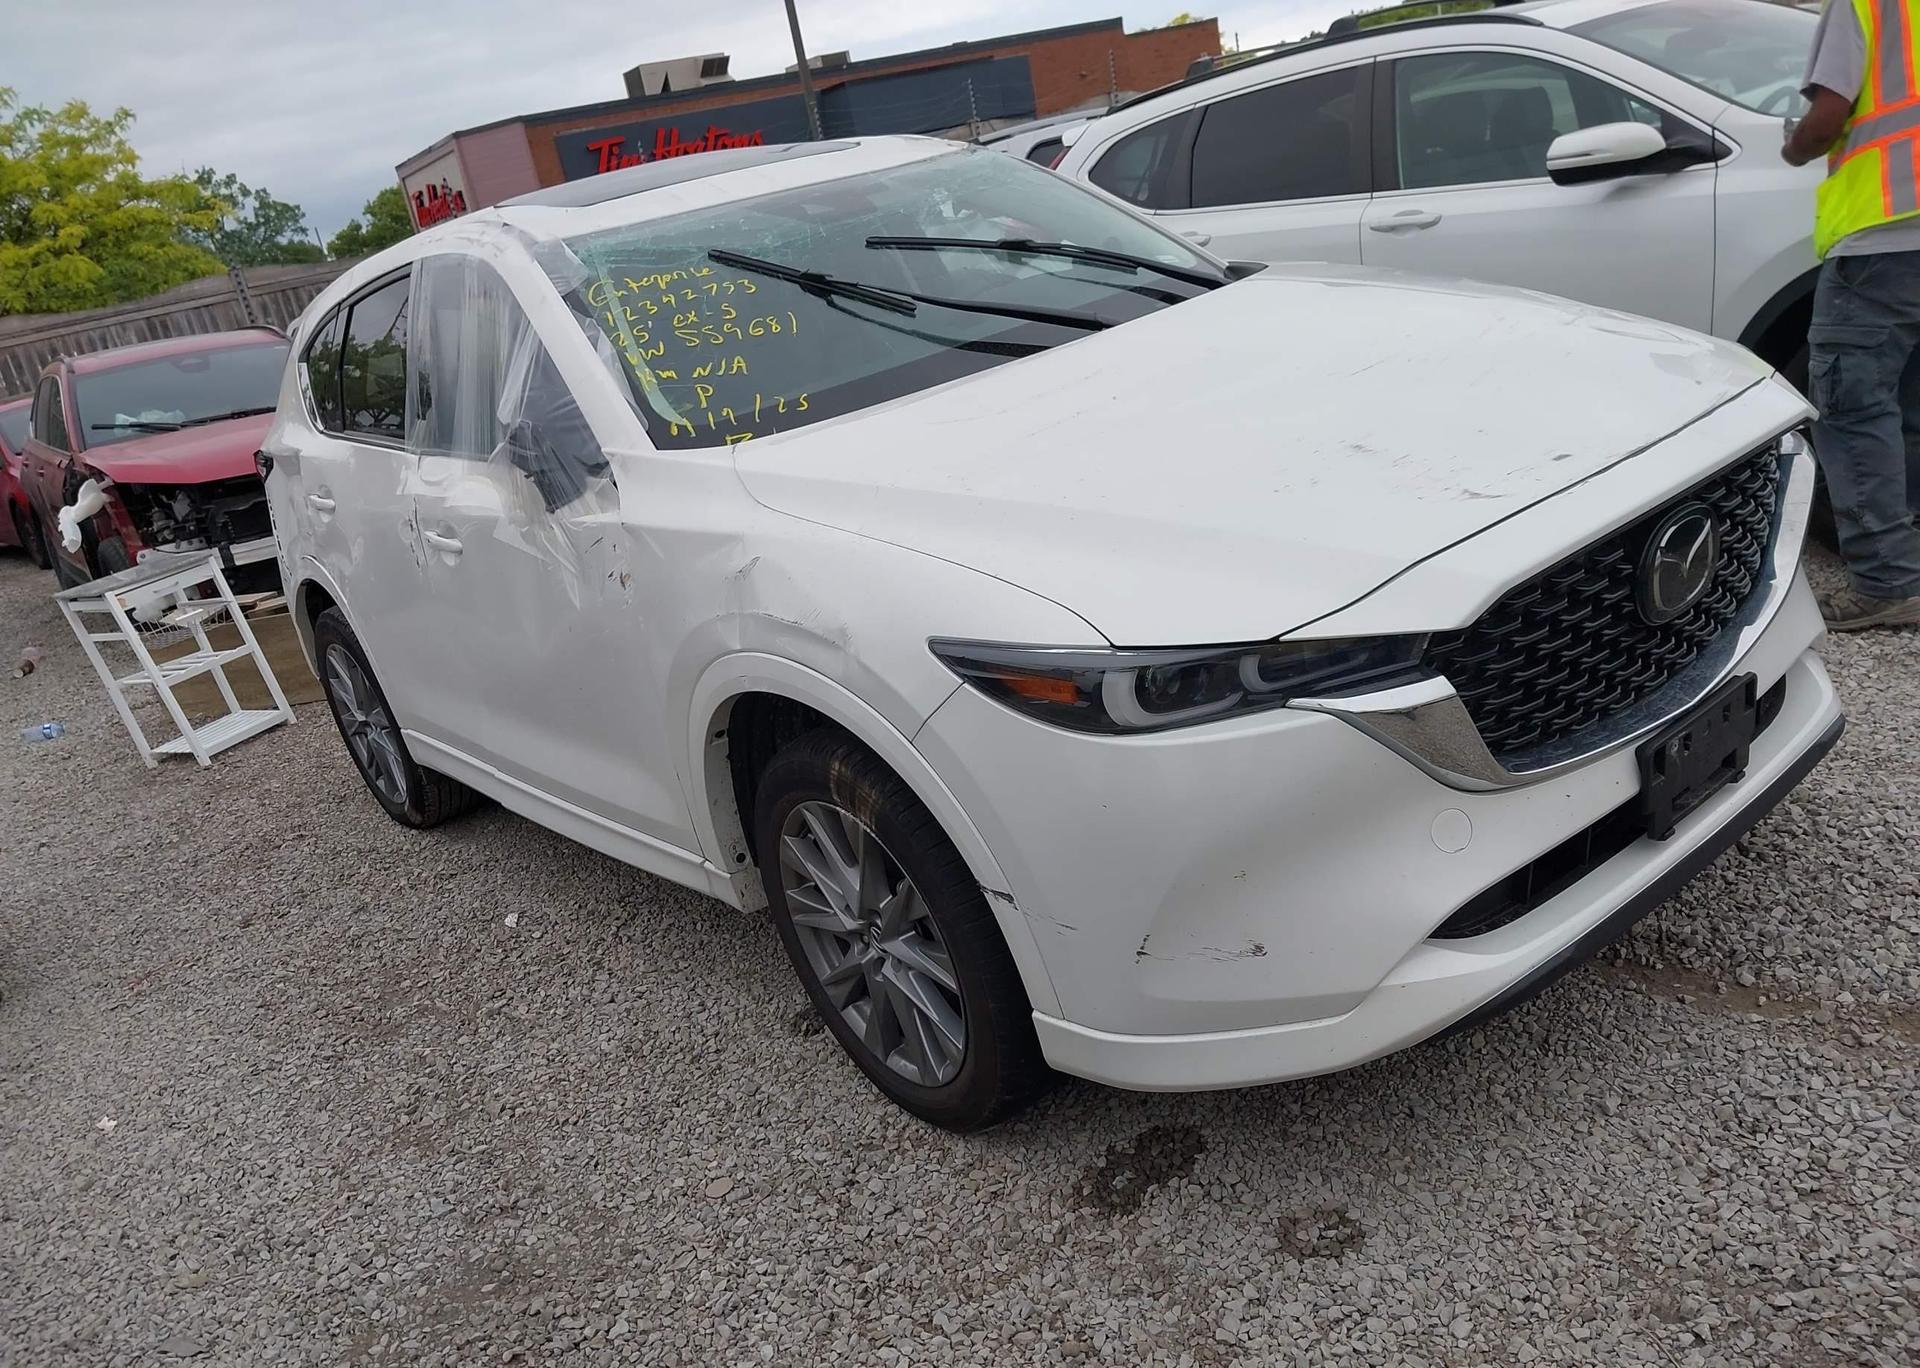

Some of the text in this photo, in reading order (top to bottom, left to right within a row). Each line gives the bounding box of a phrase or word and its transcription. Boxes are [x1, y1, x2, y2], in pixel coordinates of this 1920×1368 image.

[587, 135, 648, 174] Tim
[675, 311, 799, 347] 559681
[694, 383, 714, 409] P
